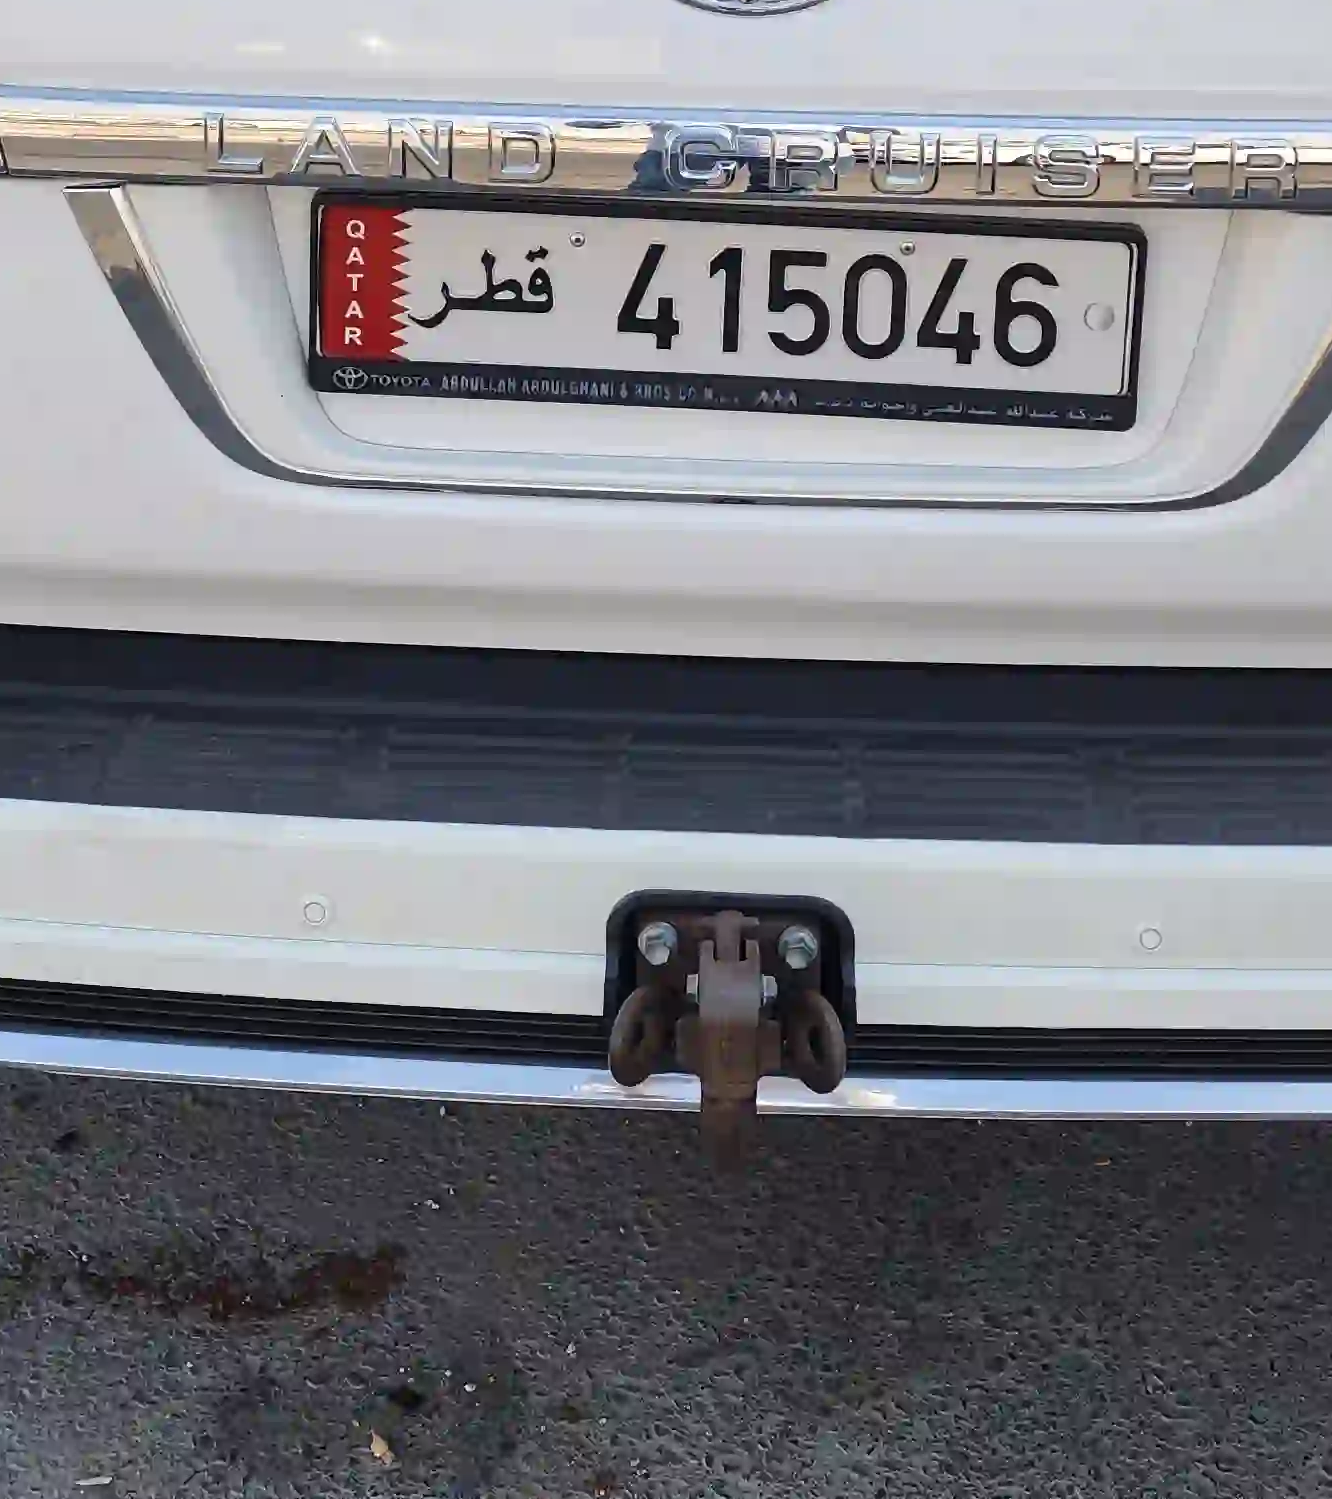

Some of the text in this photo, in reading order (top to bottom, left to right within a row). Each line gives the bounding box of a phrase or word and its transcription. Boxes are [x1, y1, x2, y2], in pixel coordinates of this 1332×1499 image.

[203, 112, 1300, 202] LAND CRUISER
[343, 219, 366, 347] QATAR
[407, 245, 556, 329] قطر
[617, 243, 1060, 368] 415046
[370, 373, 432, 389] TOYOTA
[440, 373, 517, 395] ABDULLAH
